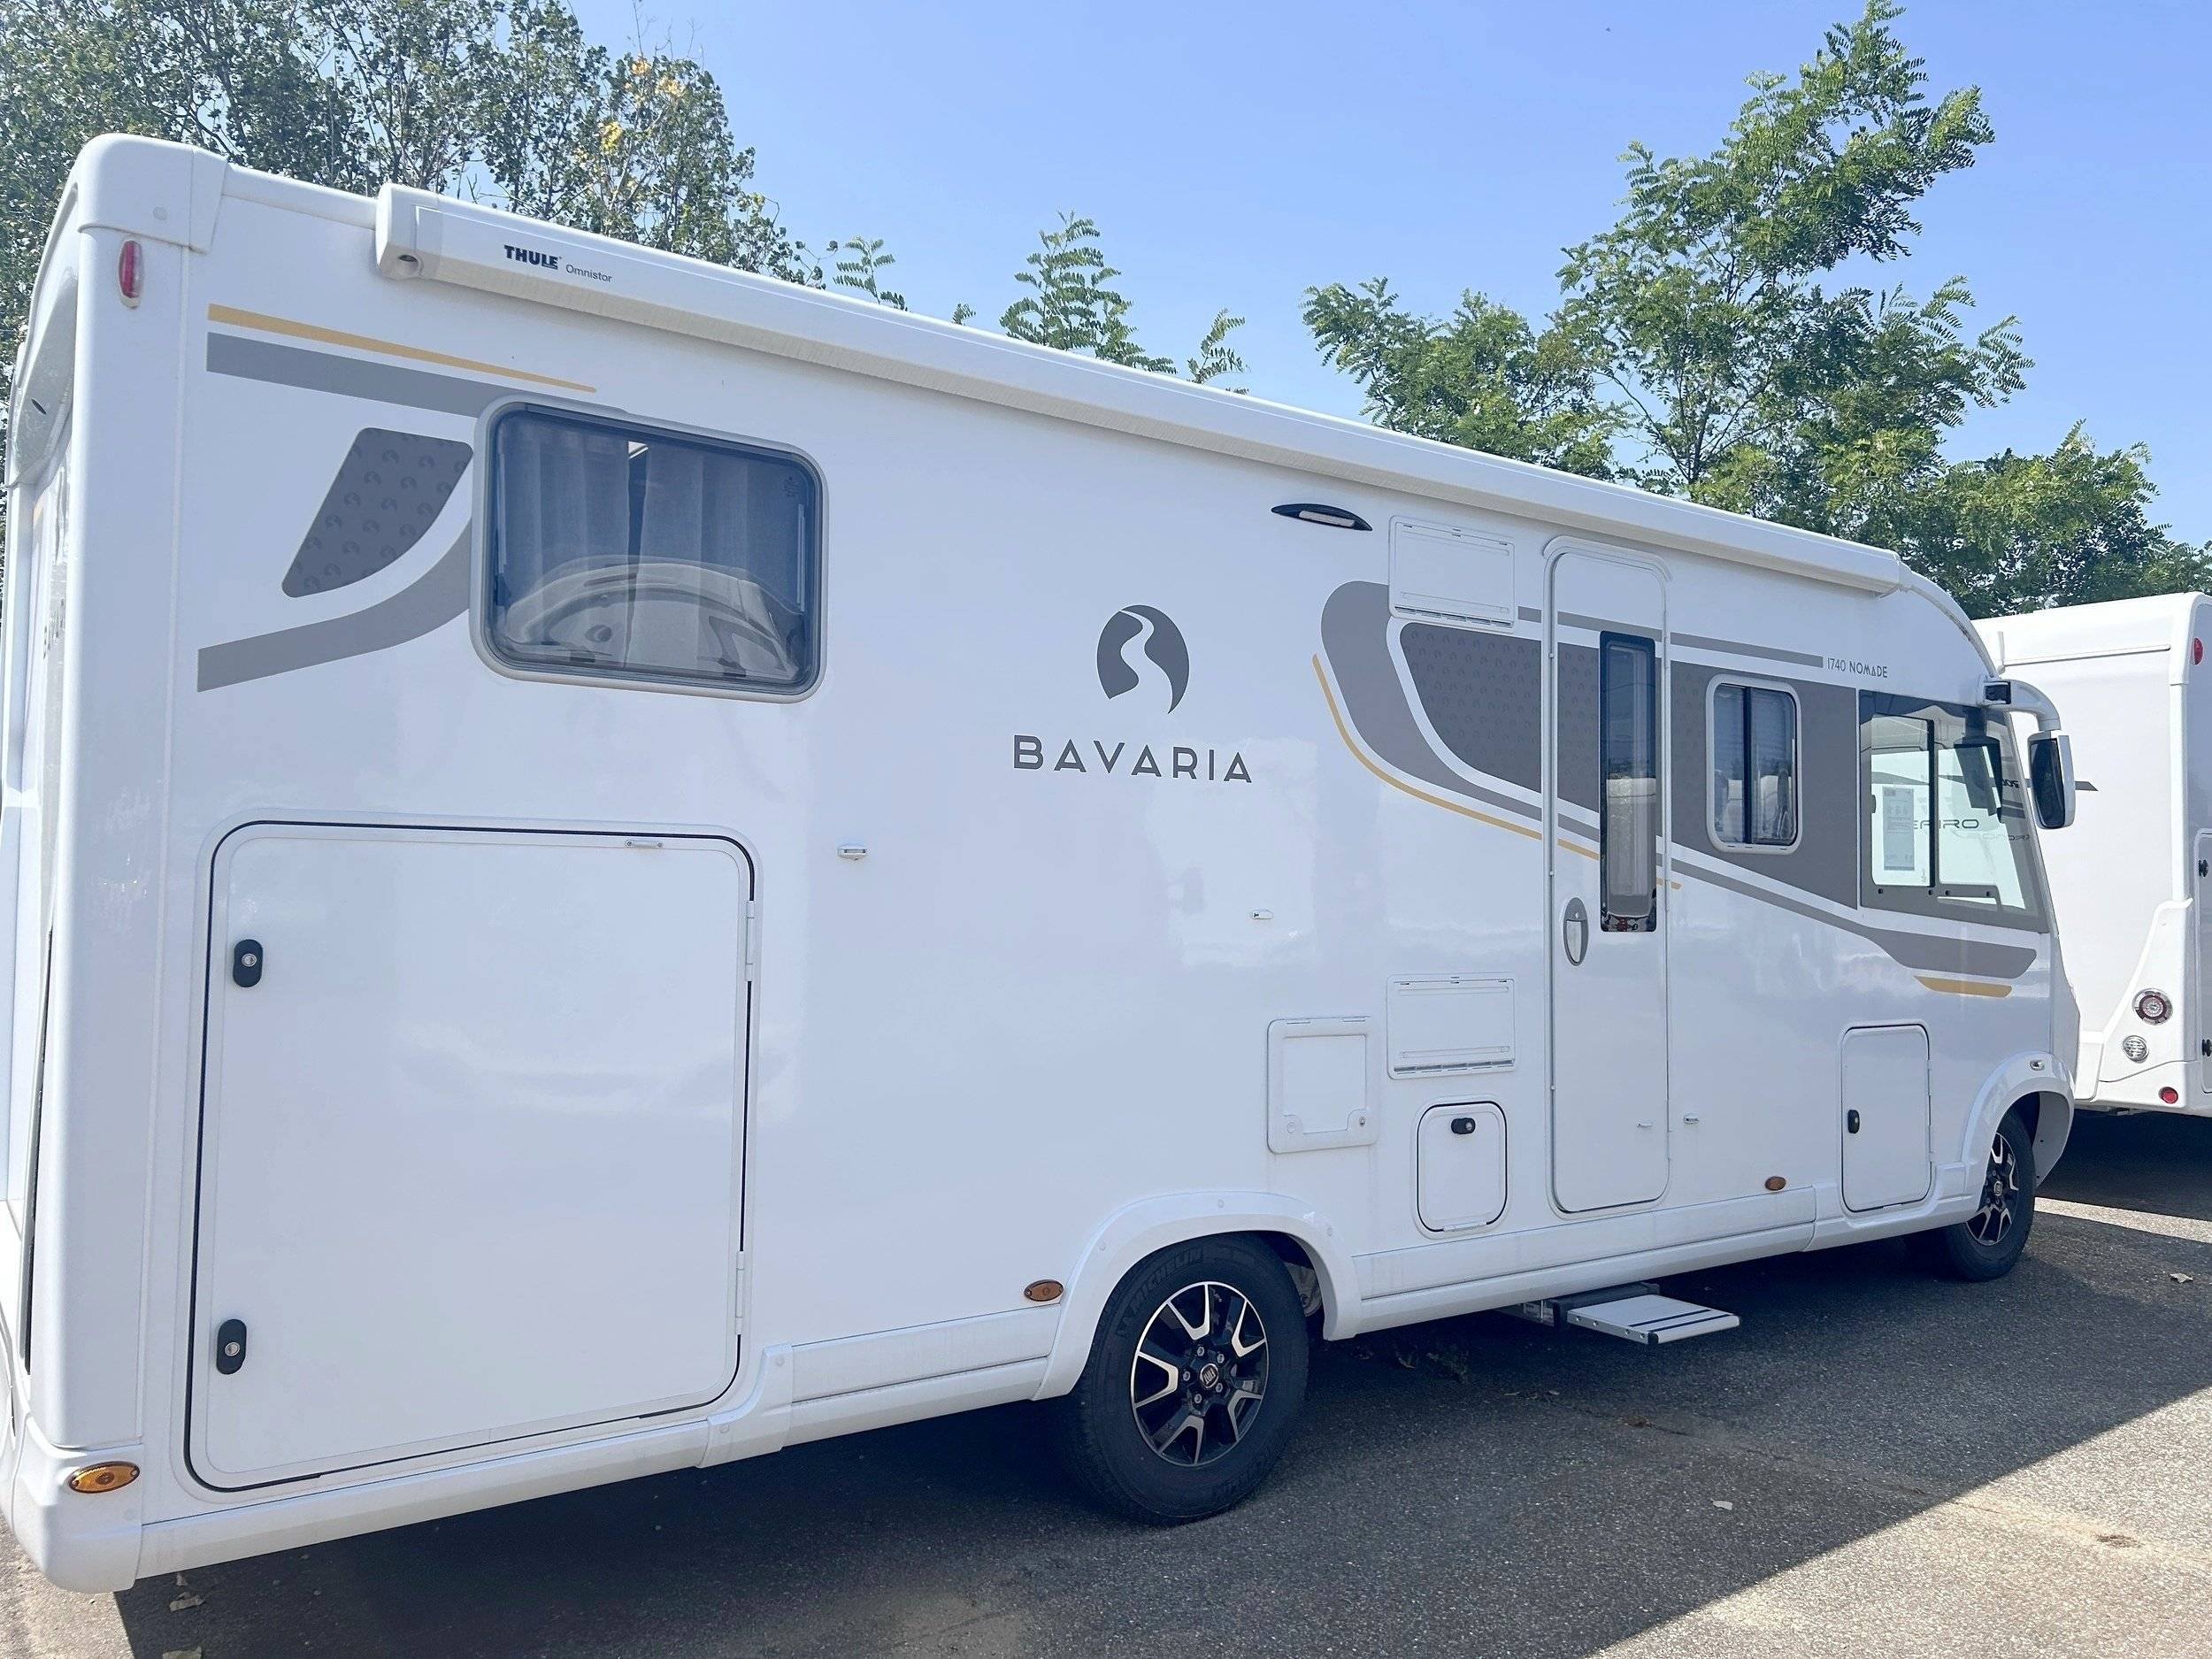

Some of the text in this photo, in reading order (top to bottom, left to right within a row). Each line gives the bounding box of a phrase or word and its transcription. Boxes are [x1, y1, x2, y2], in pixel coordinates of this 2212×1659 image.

[503, 244, 612, 282] THULE Omnistor
[1849, 661, 1888, 678] NOMADE
[1014, 734, 1252, 783] BAVARIA
